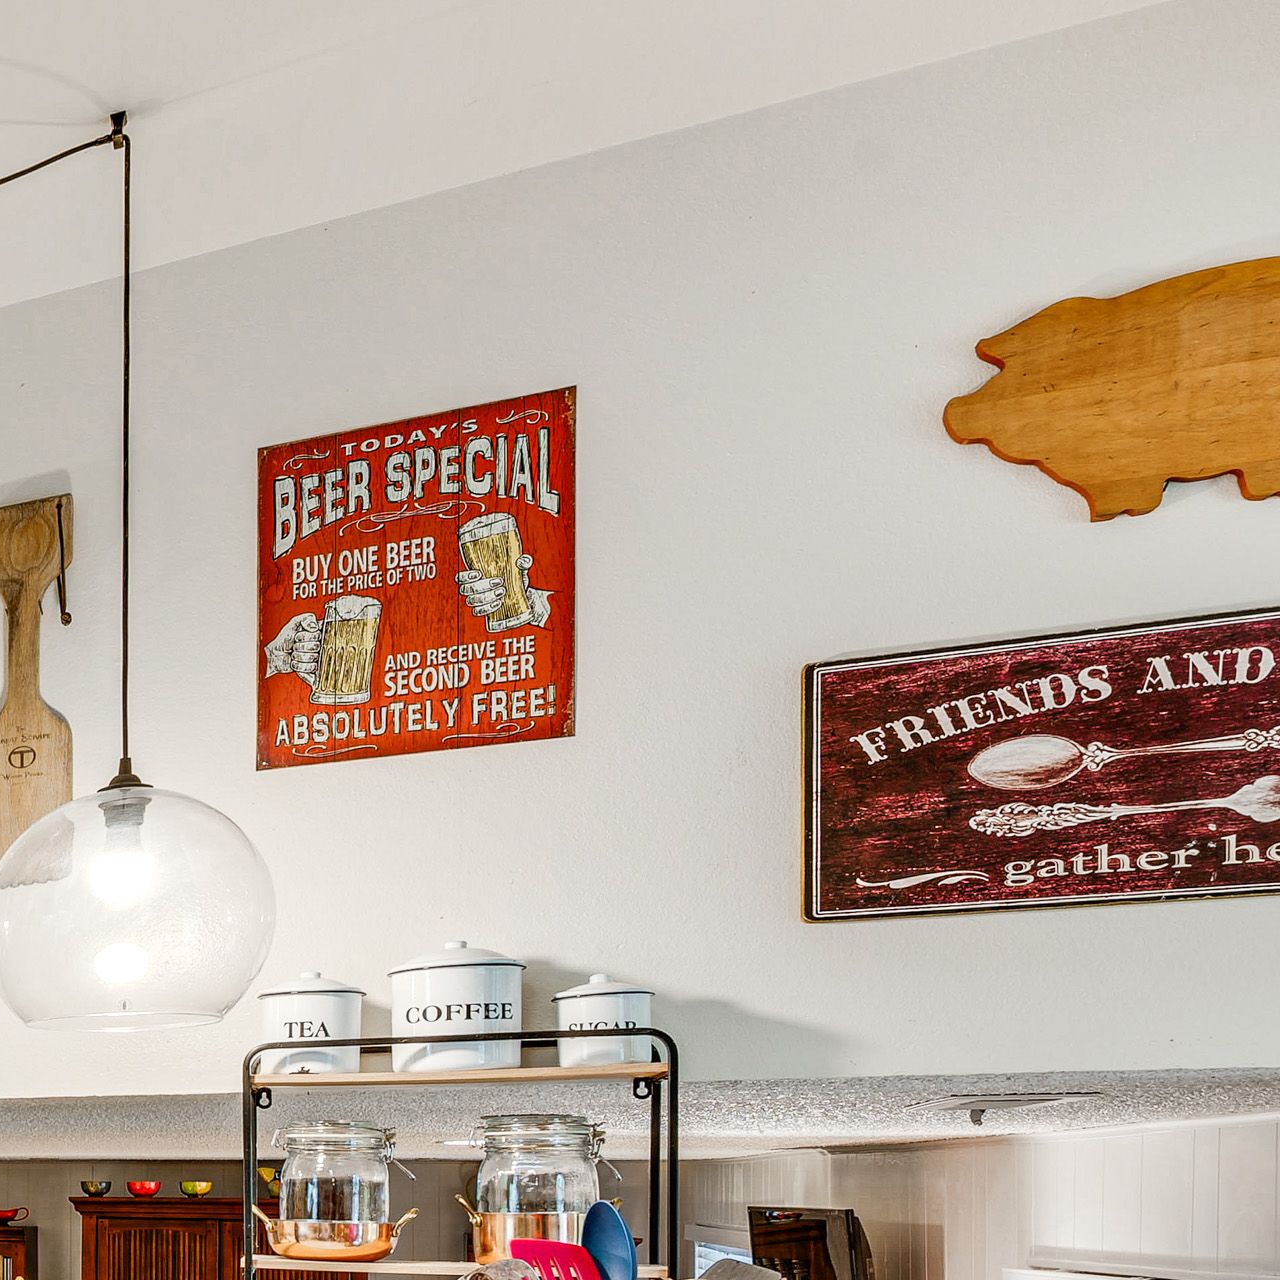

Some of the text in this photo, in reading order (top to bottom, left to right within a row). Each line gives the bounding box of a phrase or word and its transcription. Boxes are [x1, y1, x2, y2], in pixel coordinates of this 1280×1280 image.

[341, 419, 479, 456] TODAY'S
[273, 427, 560, 560] BEER SPECIAL
[292, 536, 435, 584] BUY ONE BEER
[292, 563, 436, 600] FOR THE PRICE OF TWO
[384, 635, 535, 671] AND RECEIVE THE
[384, 655, 535, 697] SECOND BEER
[274, 683, 557, 747] ABSOLUTELY FREE!
[849, 645, 1278, 767] FRIENDS AND
[1002, 839, 1201, 887] gather
[283, 1020, 332, 1039] TEA
[405, 1002, 515, 1025] COFFEE
